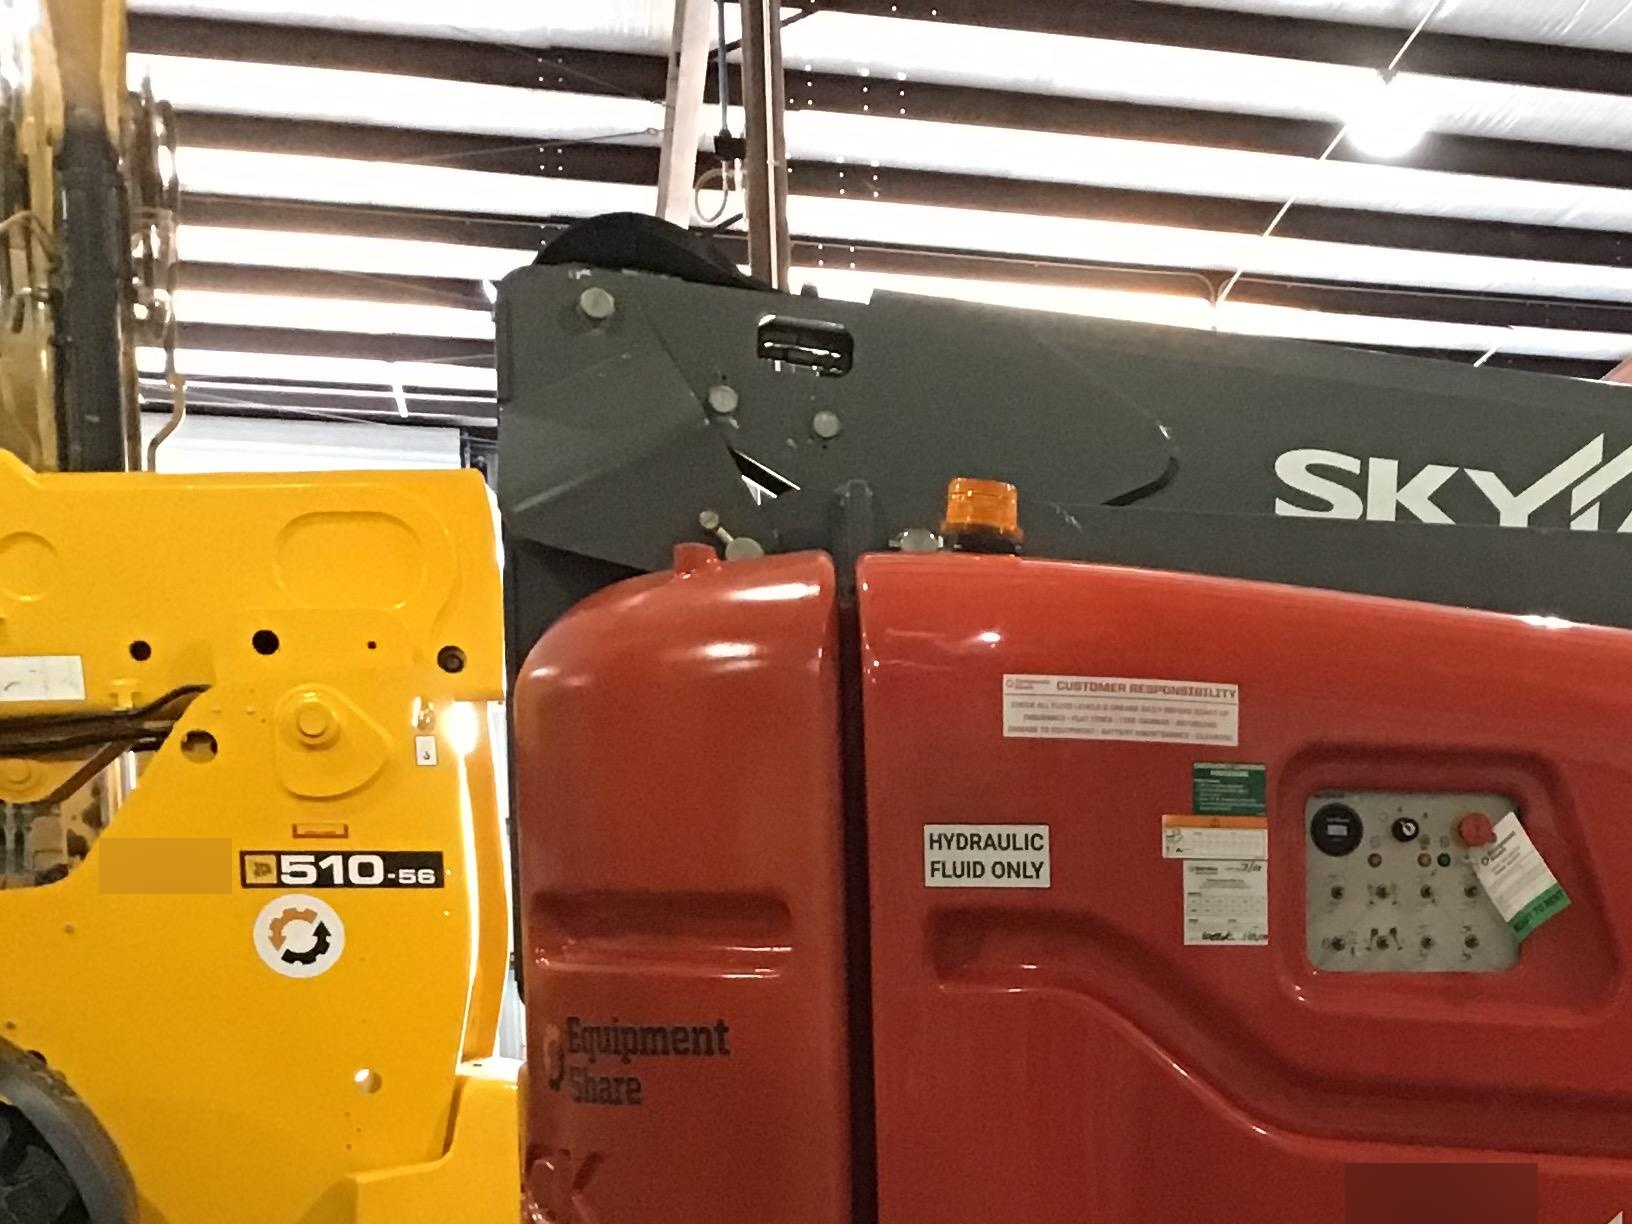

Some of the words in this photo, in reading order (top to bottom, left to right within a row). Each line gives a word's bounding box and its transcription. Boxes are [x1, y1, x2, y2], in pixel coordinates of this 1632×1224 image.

[1056, 680, 1127, 693] CUSTOMER
[1129, 683, 1237, 698] RESPONSIBILITY
[929, 832, 1044, 851] HYDRAULIC
[279, 854, 436, 886] 510-56
[930, 860, 986, 879] FLUID
[991, 861, 1044, 879] ONLY
[565, 1016, 731, 1065] Equipment
[569, 1066, 643, 1106] Share
